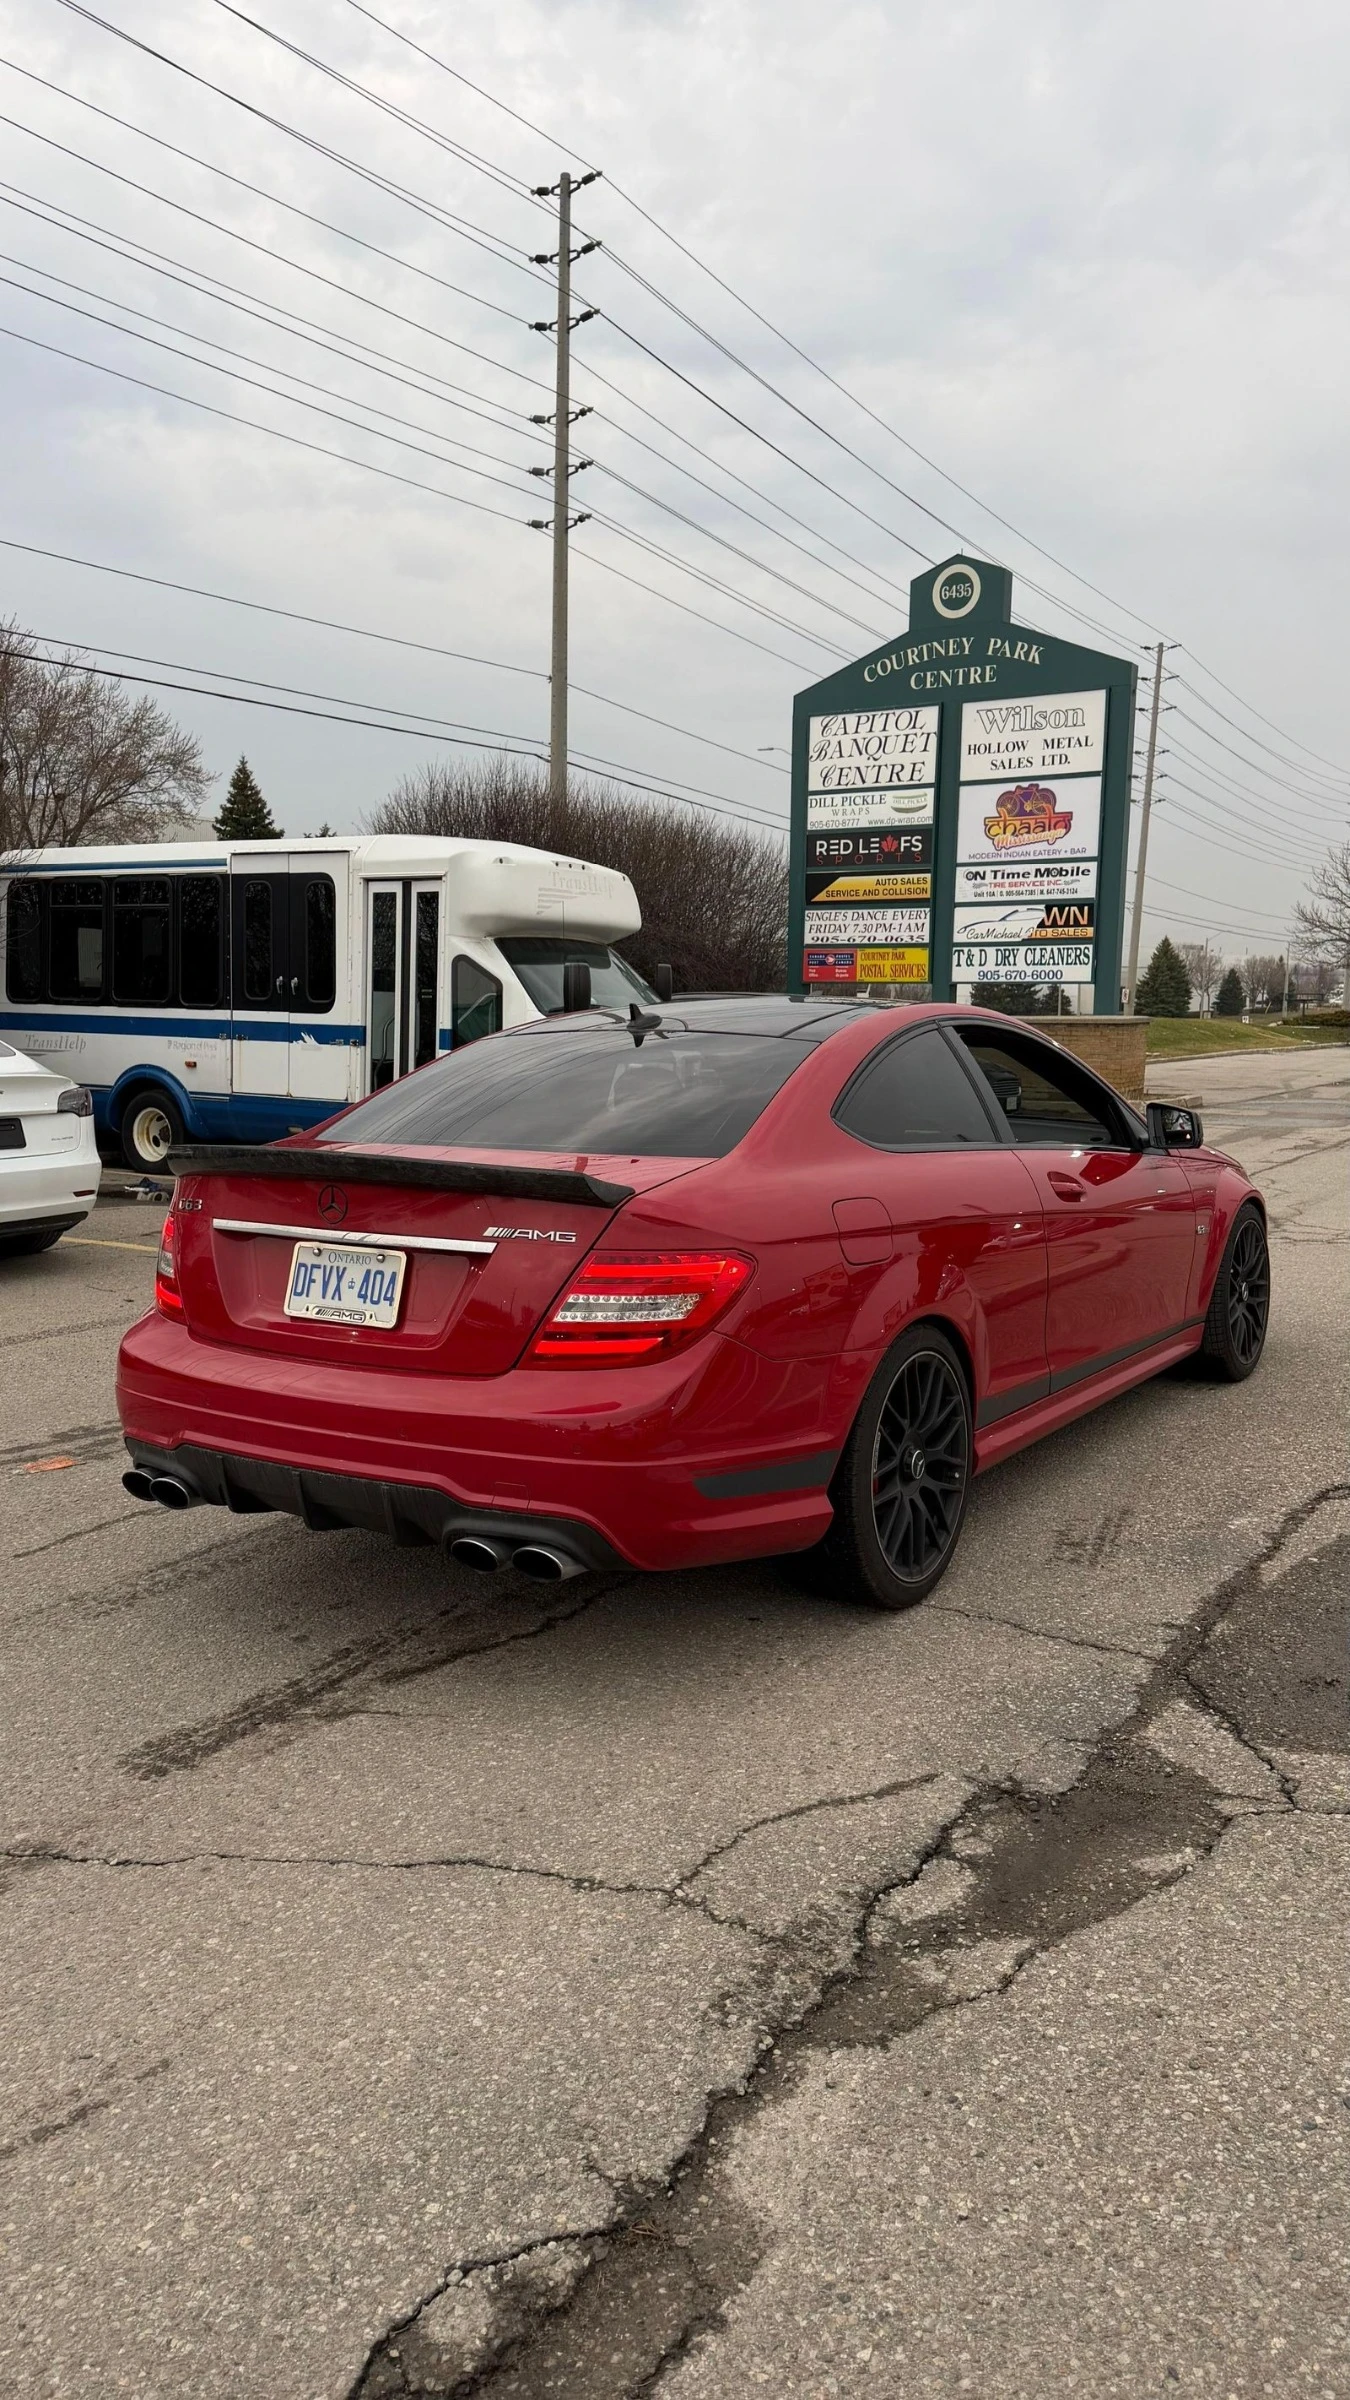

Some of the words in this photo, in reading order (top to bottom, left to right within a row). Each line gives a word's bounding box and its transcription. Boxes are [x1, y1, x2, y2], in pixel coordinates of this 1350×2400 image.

[941, 583, 972, 600] 6435
[863, 637, 975, 683] COURTNEY
[987, 637, 1046, 665] PARK
[910, 664, 997, 690] CENTRE
[820, 709, 926, 738] CAPITOL
[976, 705, 1086, 735] Wilson
[809, 731, 938, 762] BANQUET
[967, 740, 1029, 755] HOLLOW
[1042, 735, 1094, 750] METAL
[990, 756, 1034, 771] SALES
[1041, 753, 1071, 767] LTD.
[820, 761, 926, 788] CENTRE
[809, 798, 838, 809] DILL
[841, 793, 887, 807] PICKLE
[831, 807, 870, 817] WRAPS
[809, 818, 860, 829] 905-670-8777
[867, 815, 932, 826] www.dp-wrap.com
[816, 839, 854, 856] RED
[859, 835, 923, 855] LEFS
[816, 852, 922, 866] SPORTS
[968, 852, 1002, 860] MODERN
[1004, 850, 1031, 858] INDIAN
[1033, 849, 1062, 857] EATERY
[1070, 847, 1087, 855] BAR
[875, 879, 898, 887] AUTO
[900, 877, 928, 886] SALES
[990, 869, 1031, 880] Time
[1008, 880, 1045, 888] SERVICE
[825, 889, 860, 898] SERVICE
[862, 888, 880, 897] AND
[882, 887, 928, 896] COLLISION
[806, 911, 848, 922] SINGLE'S
[851, 910, 888, 921] DANCE
[892, 909, 929, 920] EVERY
[808, 923, 850, 934] FRIDAY
[966, 928, 1022, 940] CarMichael
[1051, 929, 1088, 937] SALES
[860, 953, 889, 961] COURTNEY
[891, 951, 906, 960] PARK
[953, 949, 964, 967] T
[965, 949, 975, 967] &
[978, 949, 988, 967] D
[995, 948, 1020, 966] DRY
[1024, 946, 1090, 965] CLEANERS
[860, 965, 886, 978] POSTAL
[890, 963, 926, 978] SERVICES
[977, 970, 1064, 980] 905-670-6000
[25, 1034, 87, 1051] TransHelp
[179, 1198, 203, 1210] C63
[511, 1228, 577, 1243] AMG
[293, 1262, 347, 1302] DFVX
[357, 1268, 397, 1307] 404
[330, 1310, 364, 1321] AMG
